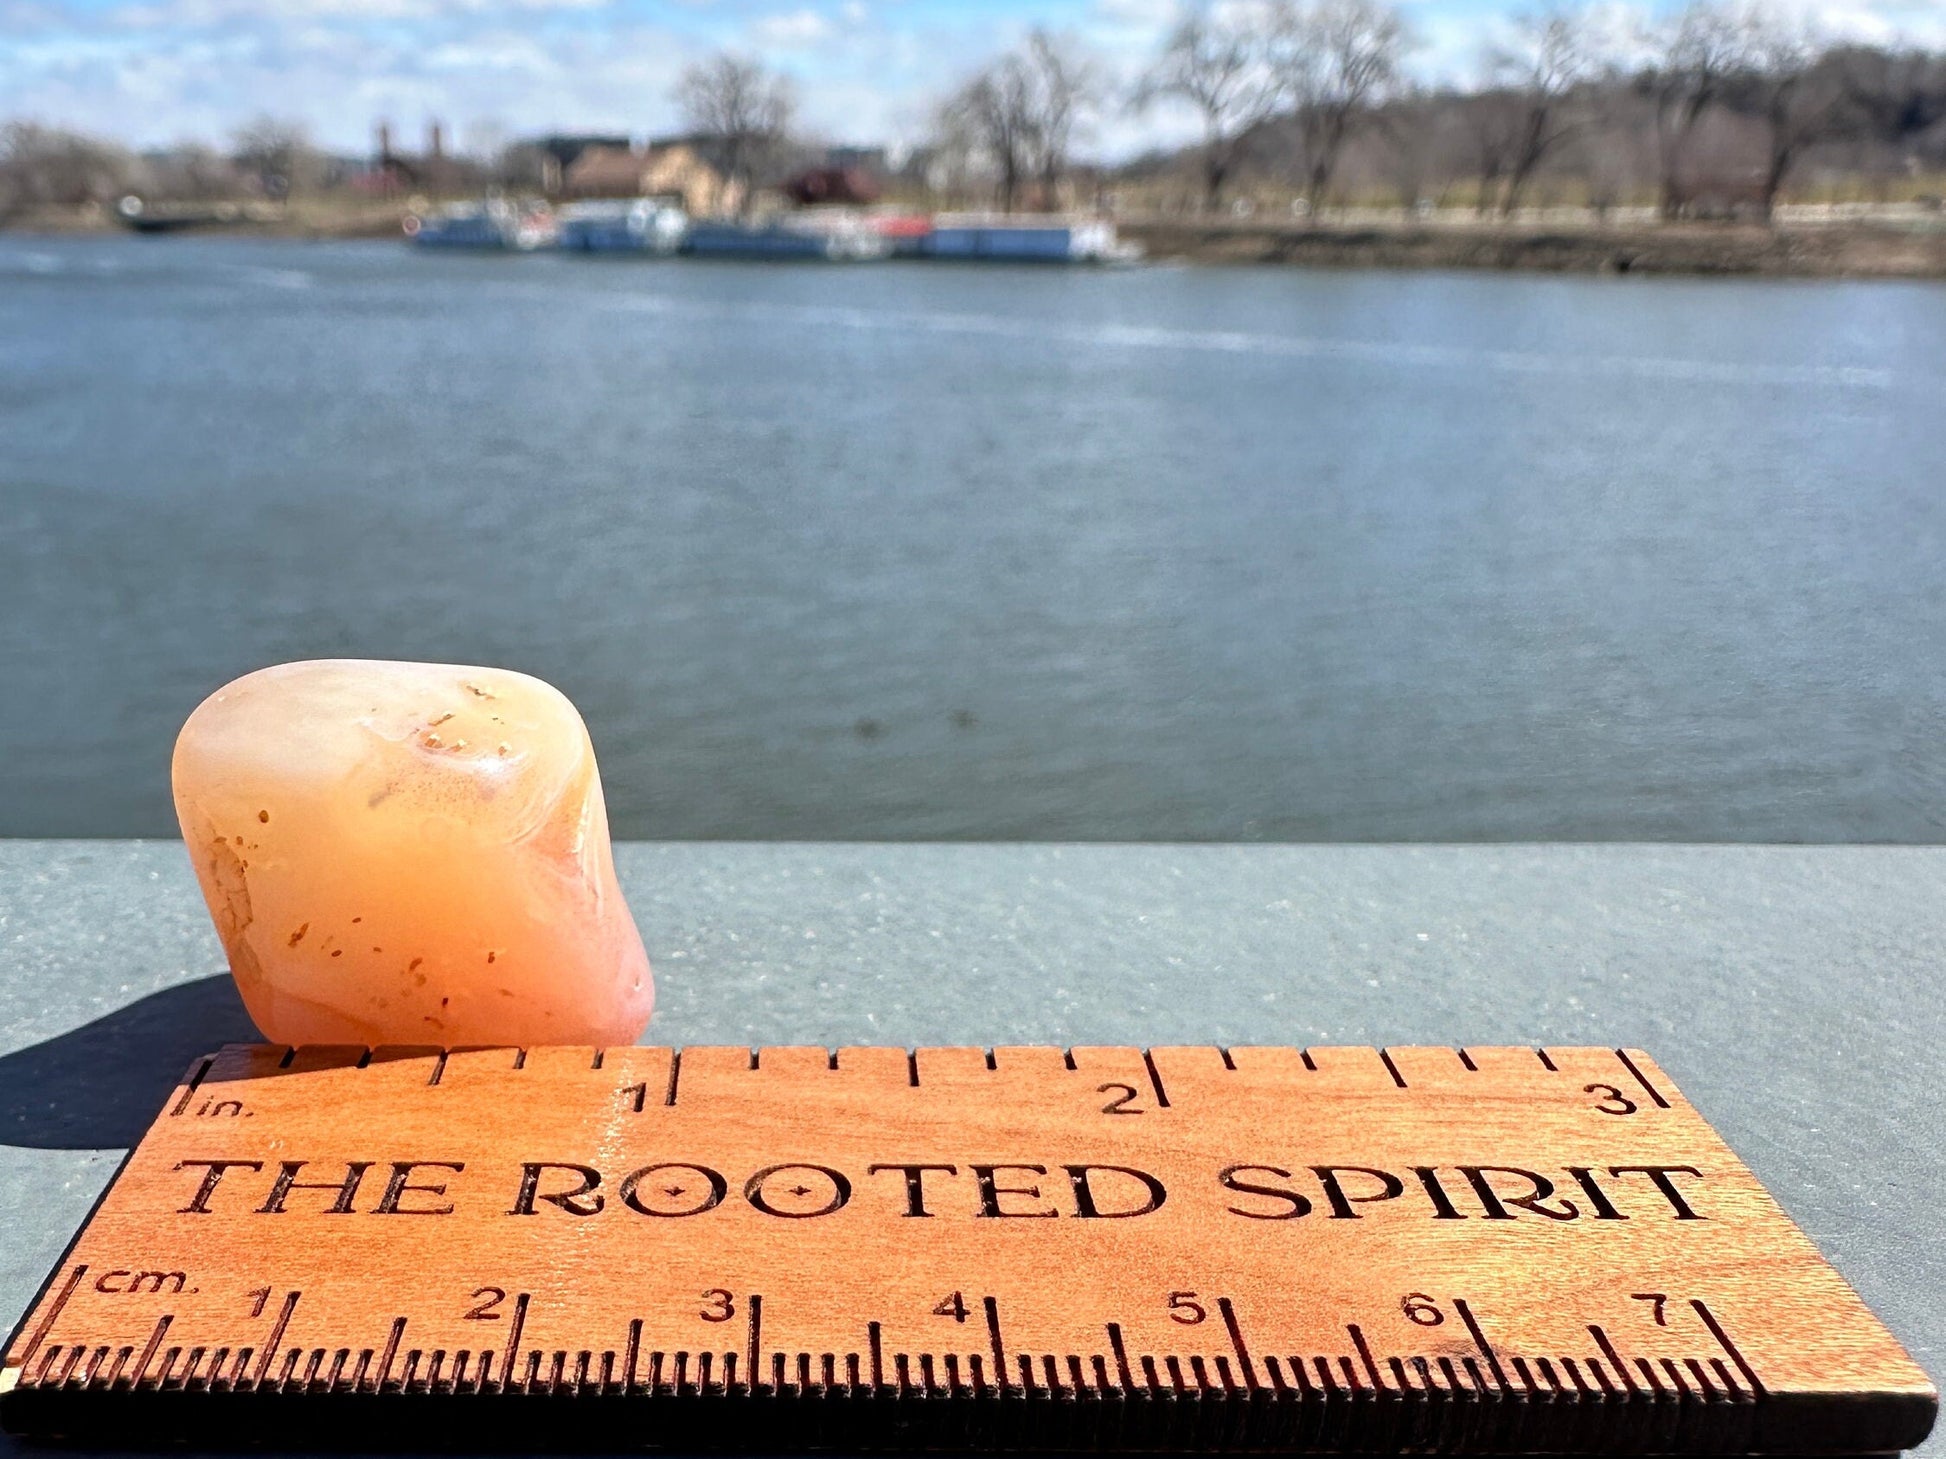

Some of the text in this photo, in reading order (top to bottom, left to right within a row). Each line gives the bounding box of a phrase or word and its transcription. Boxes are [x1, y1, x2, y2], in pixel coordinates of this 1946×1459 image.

[196, 1082, 1638, 1117] in. 1 2 3
[174, 1160, 1708, 1220] THE ROOTED SPIRIT
[95, 1268, 1668, 1326] cm. 1 2 3 4 5 6 7
